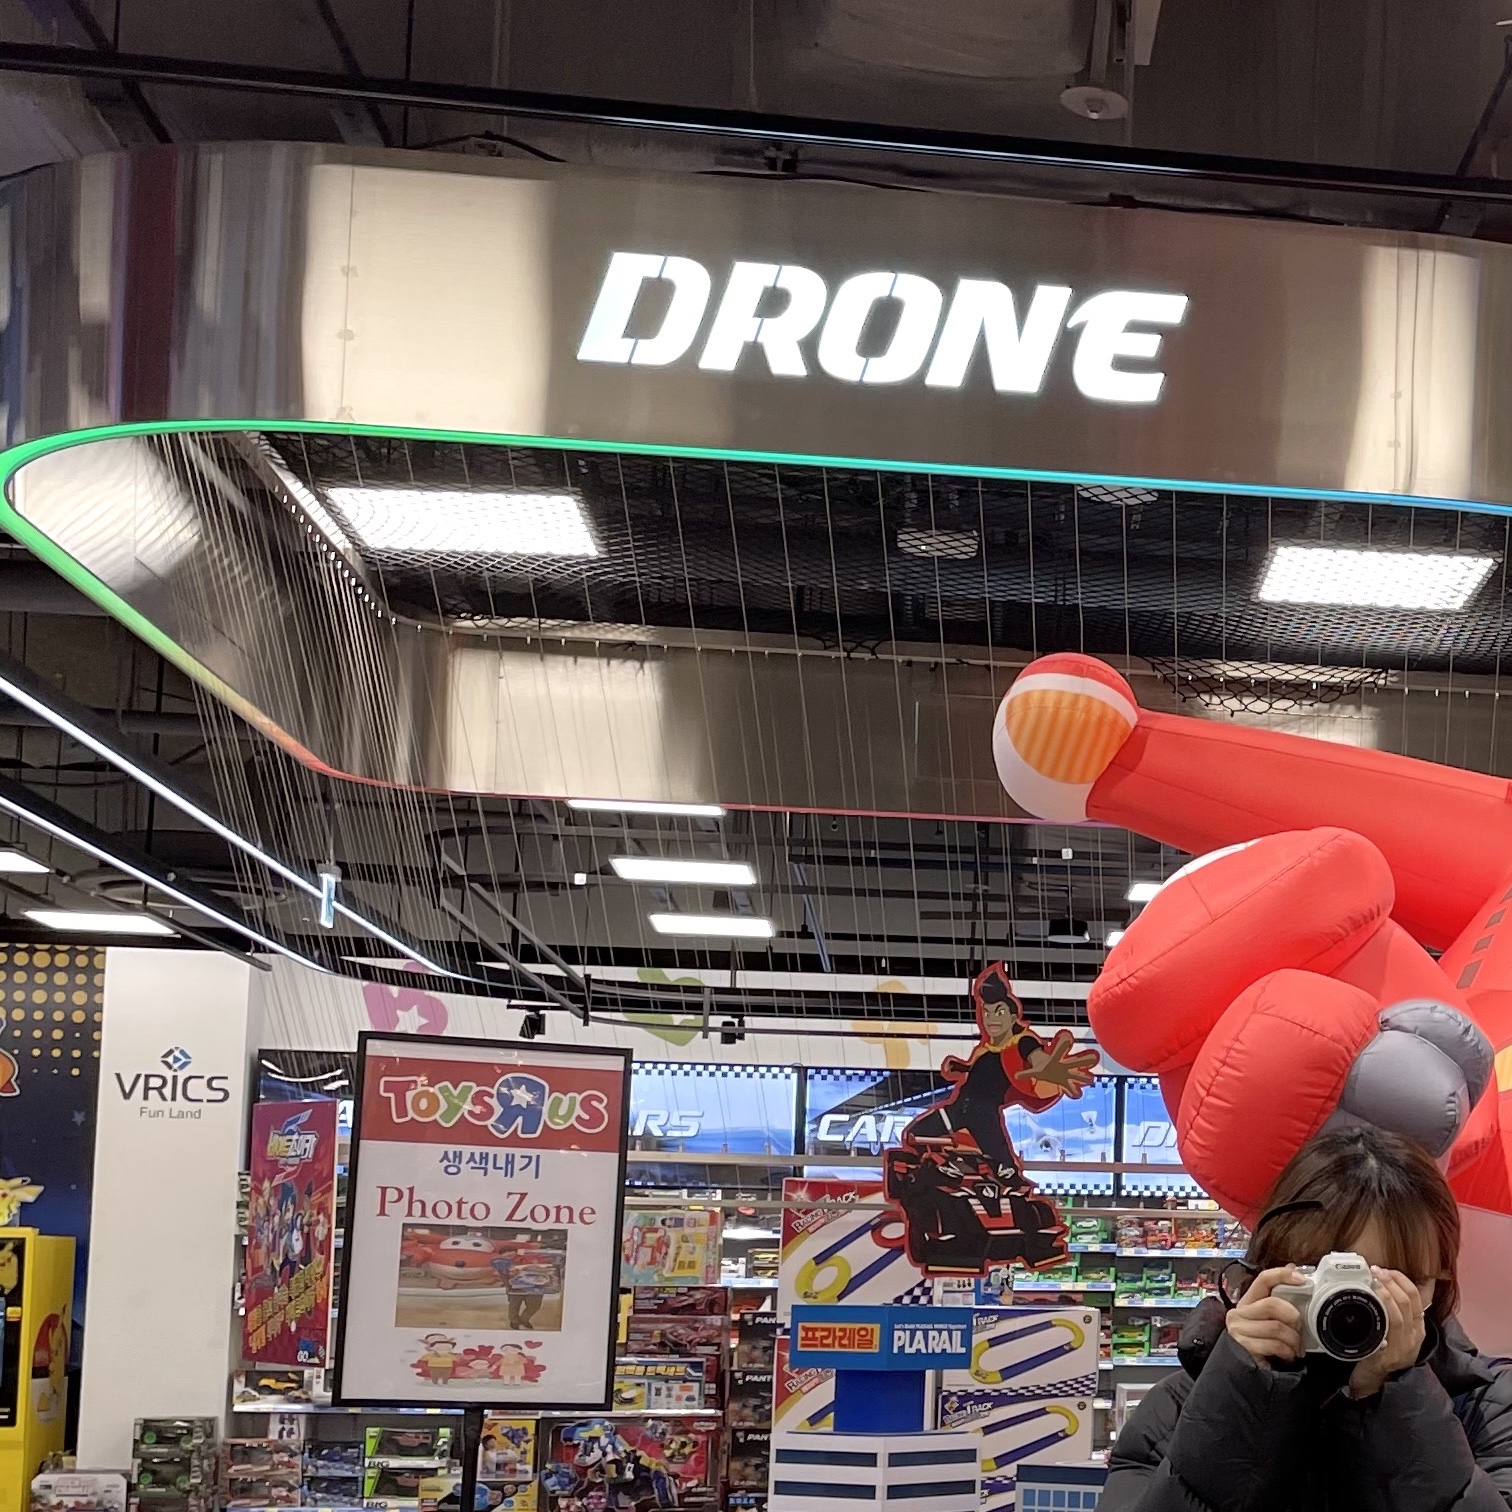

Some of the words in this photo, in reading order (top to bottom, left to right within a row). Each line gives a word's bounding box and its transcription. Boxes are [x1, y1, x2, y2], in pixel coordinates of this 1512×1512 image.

[576, 252, 1189, 403] DRONE
[115, 1072, 230, 1103] VRICS
[139, 1107, 165, 1119] Fun
[169, 1108, 201, 1119] Land
[438, 1150, 541, 1179] 생색내기
[376, 1186, 491, 1221] Photo
[504, 1192, 597, 1226] Zone
[801, 1326, 874, 1350] 프라레일
[893, 1330, 966, 1354] PLARAIL
